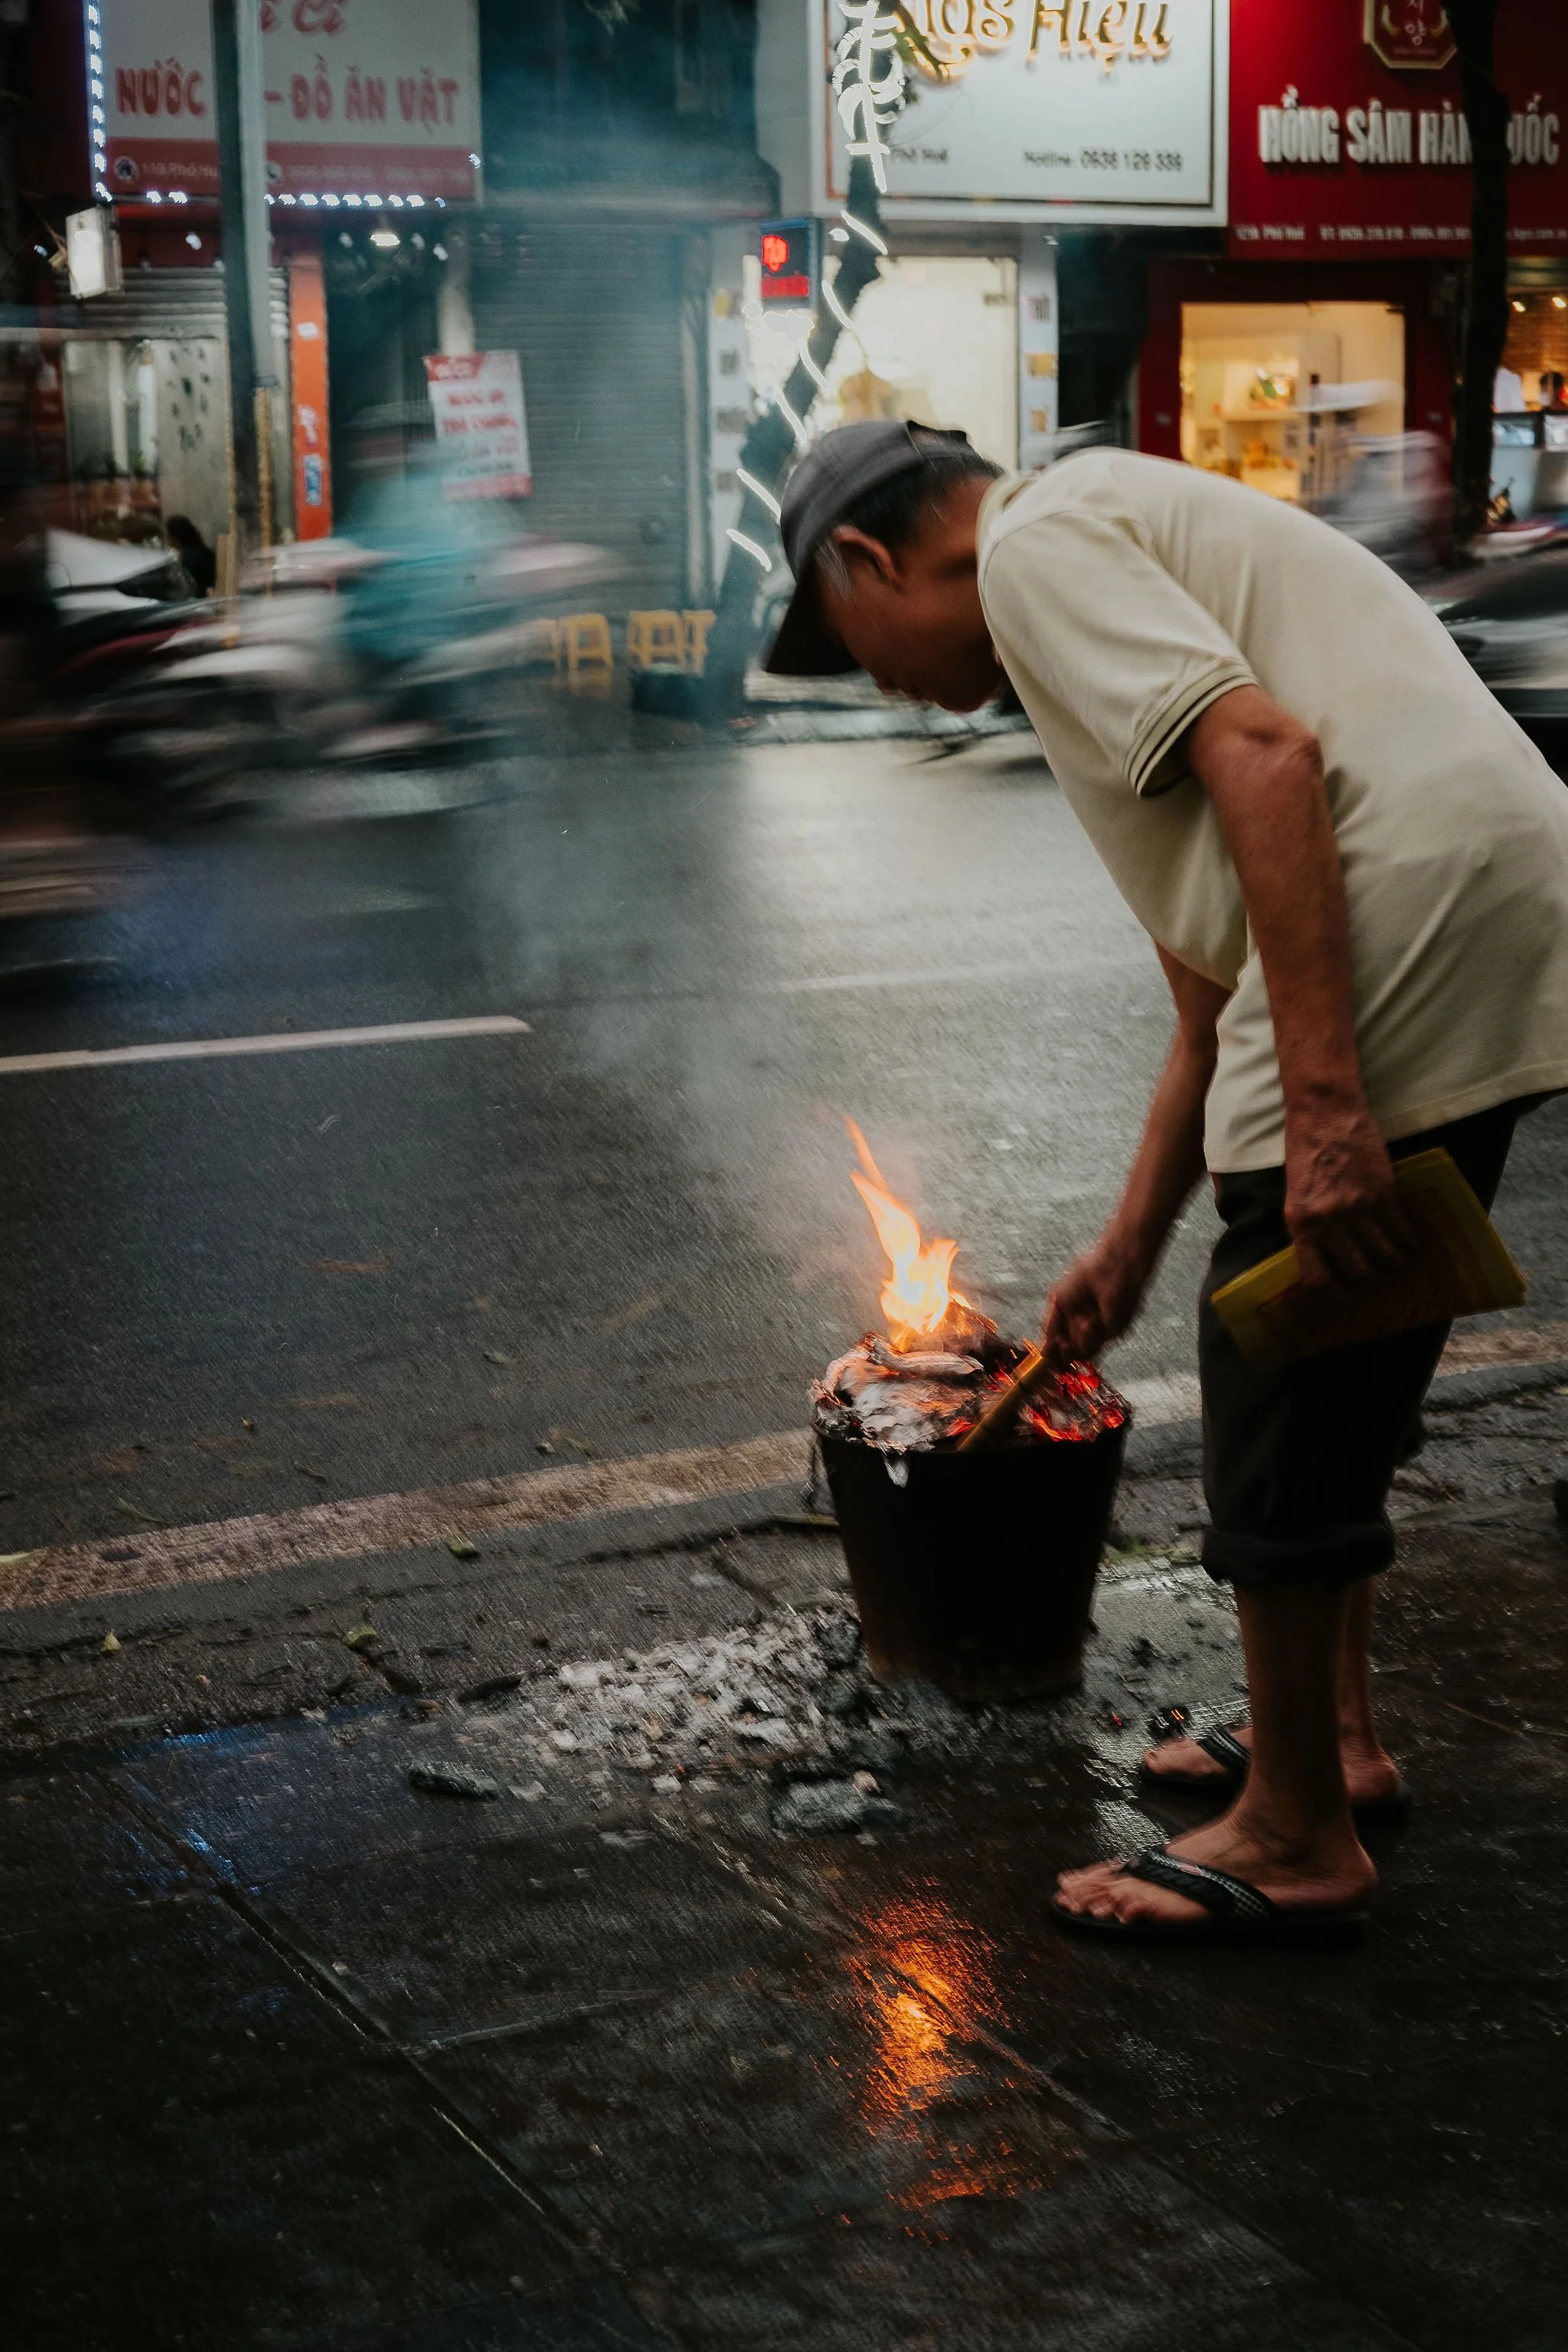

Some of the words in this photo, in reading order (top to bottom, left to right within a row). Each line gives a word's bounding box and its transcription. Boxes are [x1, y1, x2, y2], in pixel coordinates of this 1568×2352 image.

[1258, 84, 1341, 164] HỒNG
[1345, 97, 1413, 165] SÂM
[1505, 93, 1560, 165] UỐC
